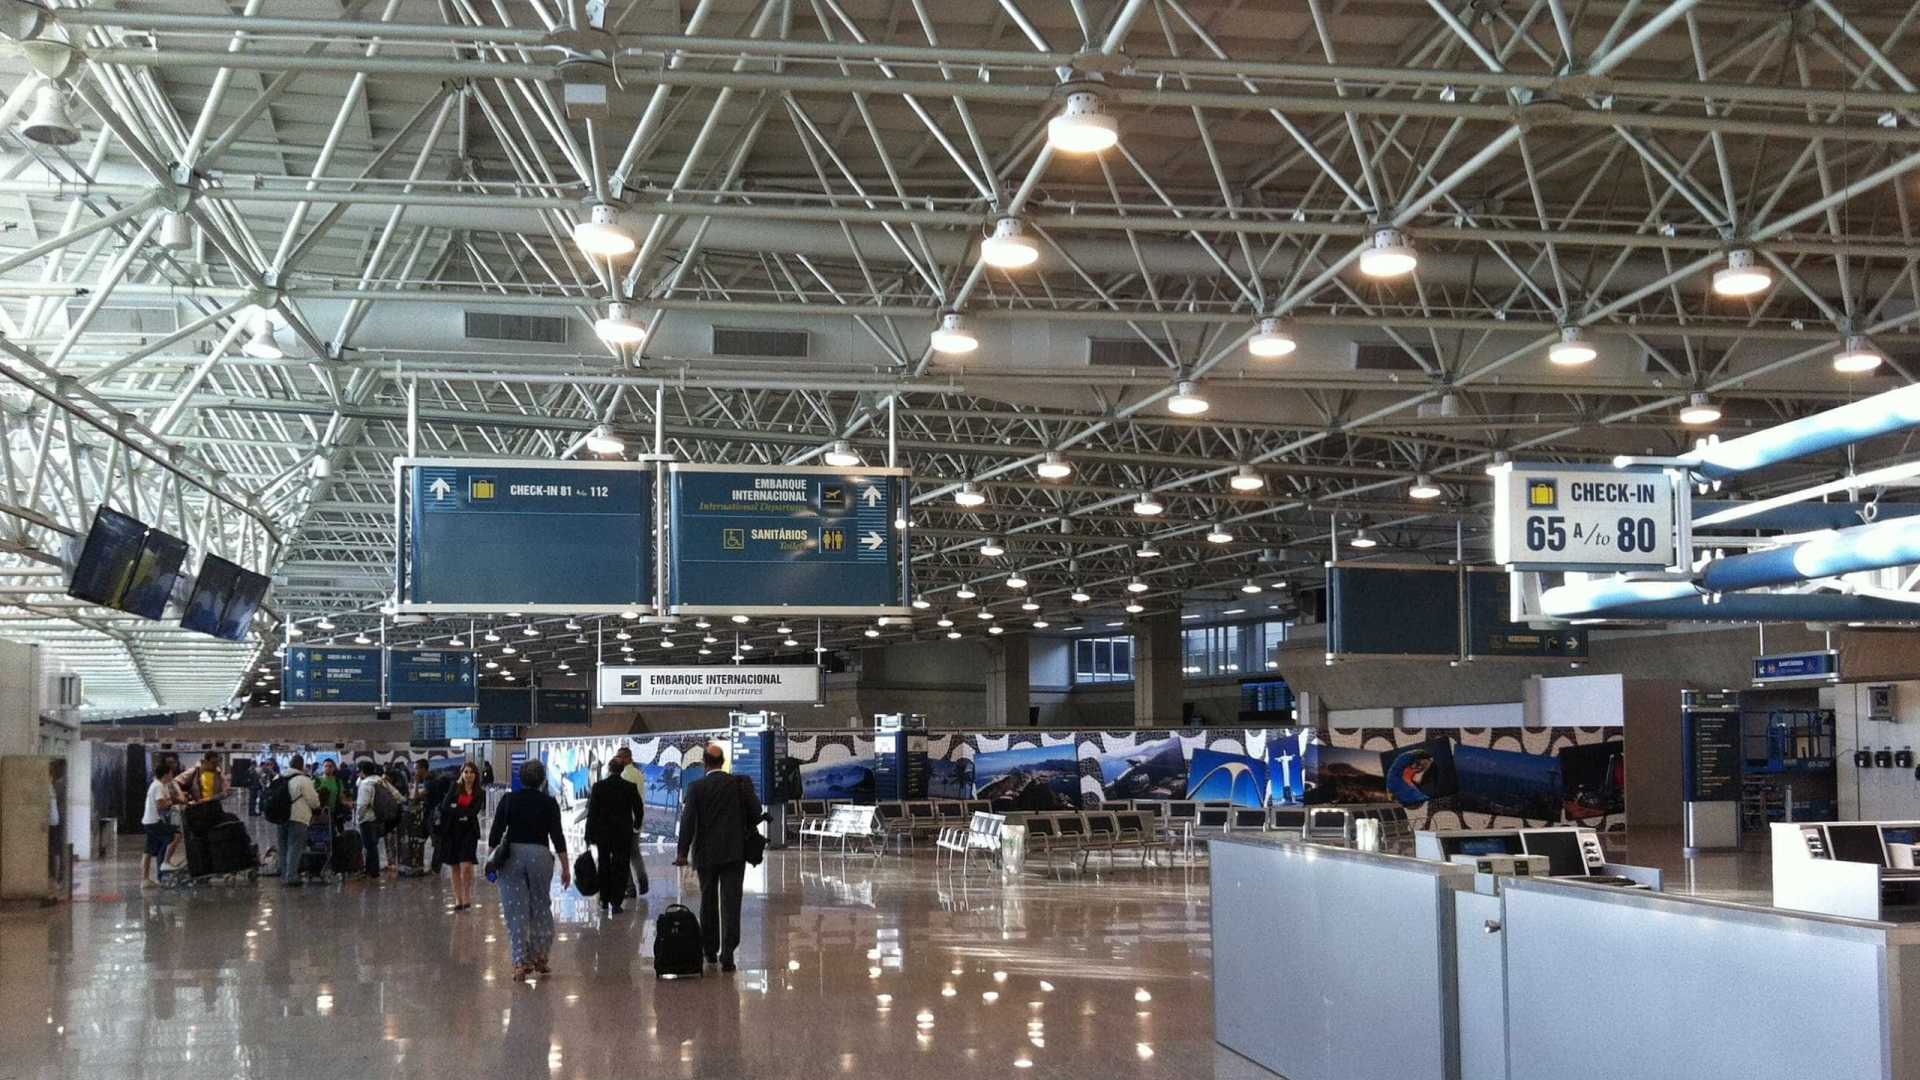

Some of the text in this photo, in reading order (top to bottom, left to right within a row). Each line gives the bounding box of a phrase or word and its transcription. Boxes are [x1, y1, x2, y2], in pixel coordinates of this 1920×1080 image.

[510, 484, 558, 497] CHECK-IN
[560, 485, 572, 497] 81
[590, 486, 609, 497] 112
[755, 479, 807, 490] EMBARQUE
[732, 490, 807, 502] INTERNACIONAL
[1571, 482, 1655, 503] CHECK-IN
[751, 528, 808, 541] SANITÁRIOS
[1526, 515, 1566, 552] 65
[1617, 516, 1656, 553] 80
[650, 674, 782, 685] EMBARQUE INTERNACIONAL
[651, 686, 763, 697] International Departures
